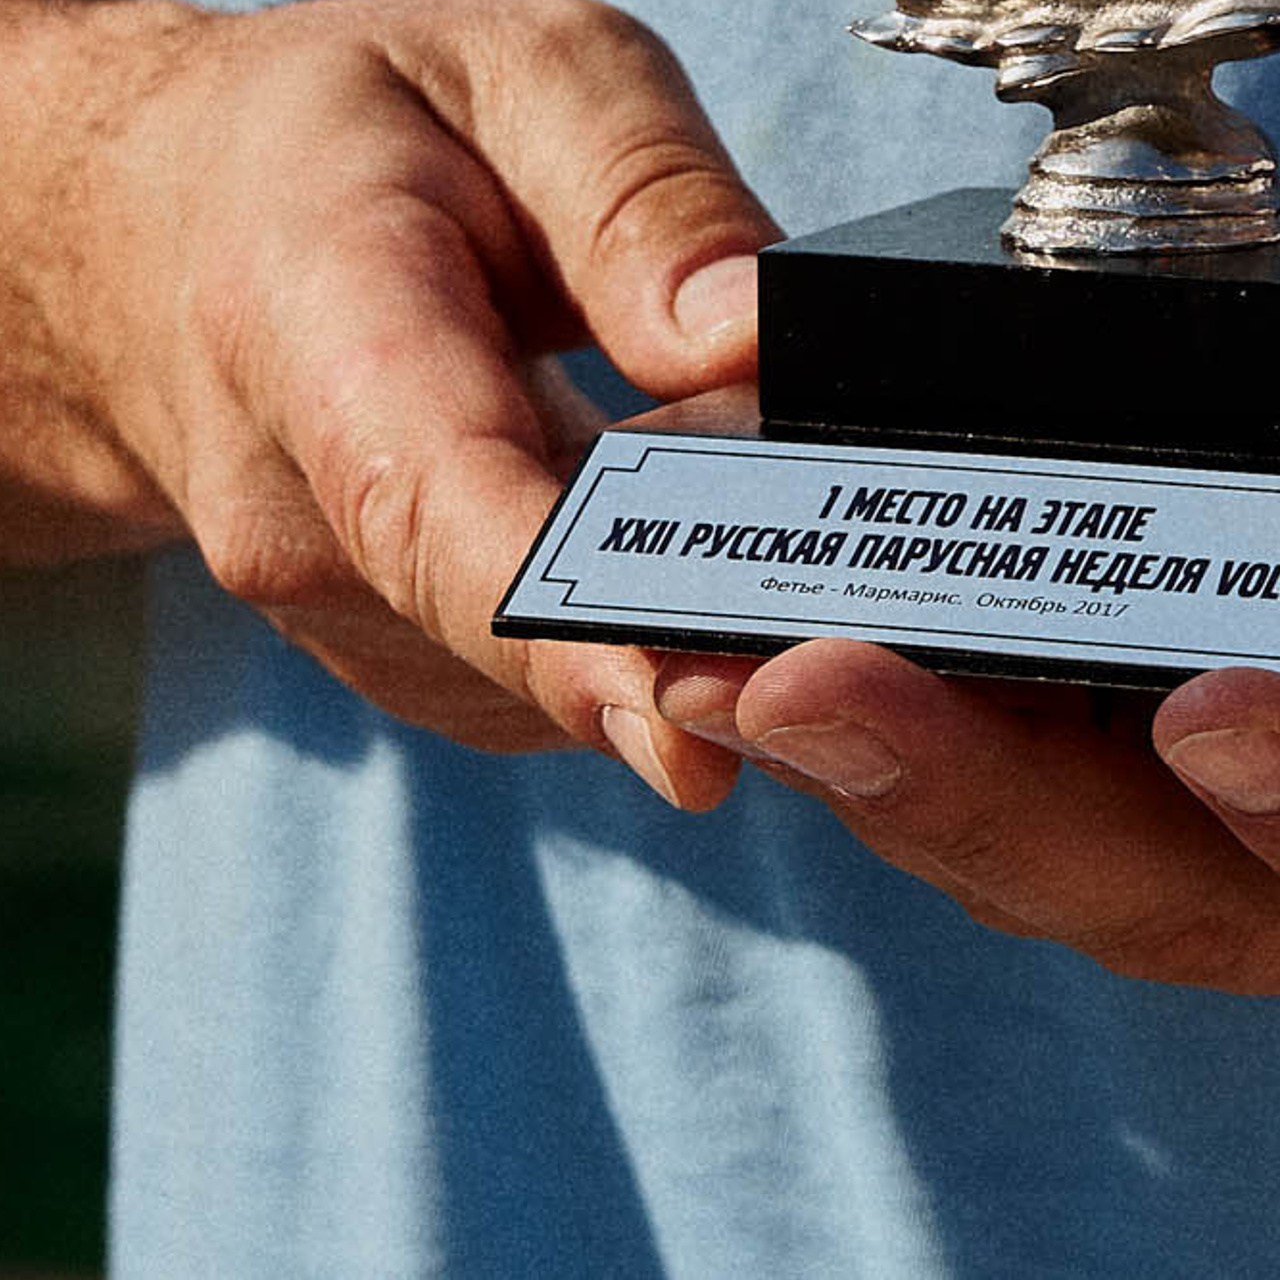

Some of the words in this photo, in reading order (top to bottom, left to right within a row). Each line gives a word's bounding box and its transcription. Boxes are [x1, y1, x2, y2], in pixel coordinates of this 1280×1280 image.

[844, 487, 968, 529] МЕСТО
[970, 494, 1028, 533] НА
[1031, 499, 1157, 542] ЭТАПЕ
[598, 517, 681, 556] XXII
[678, 522, 849, 566] РУССКАЯ
[847, 532, 1050, 583] ПАРУСНАЯ
[1049, 548, 1212, 595] НЕДЕЛЯ
[759, 576, 825, 596] Фетье
[842, 582, 964, 607] Мармарис.
[975, 592, 1069, 616] Октябрь
[1073, 600, 1131, 618] 2017
